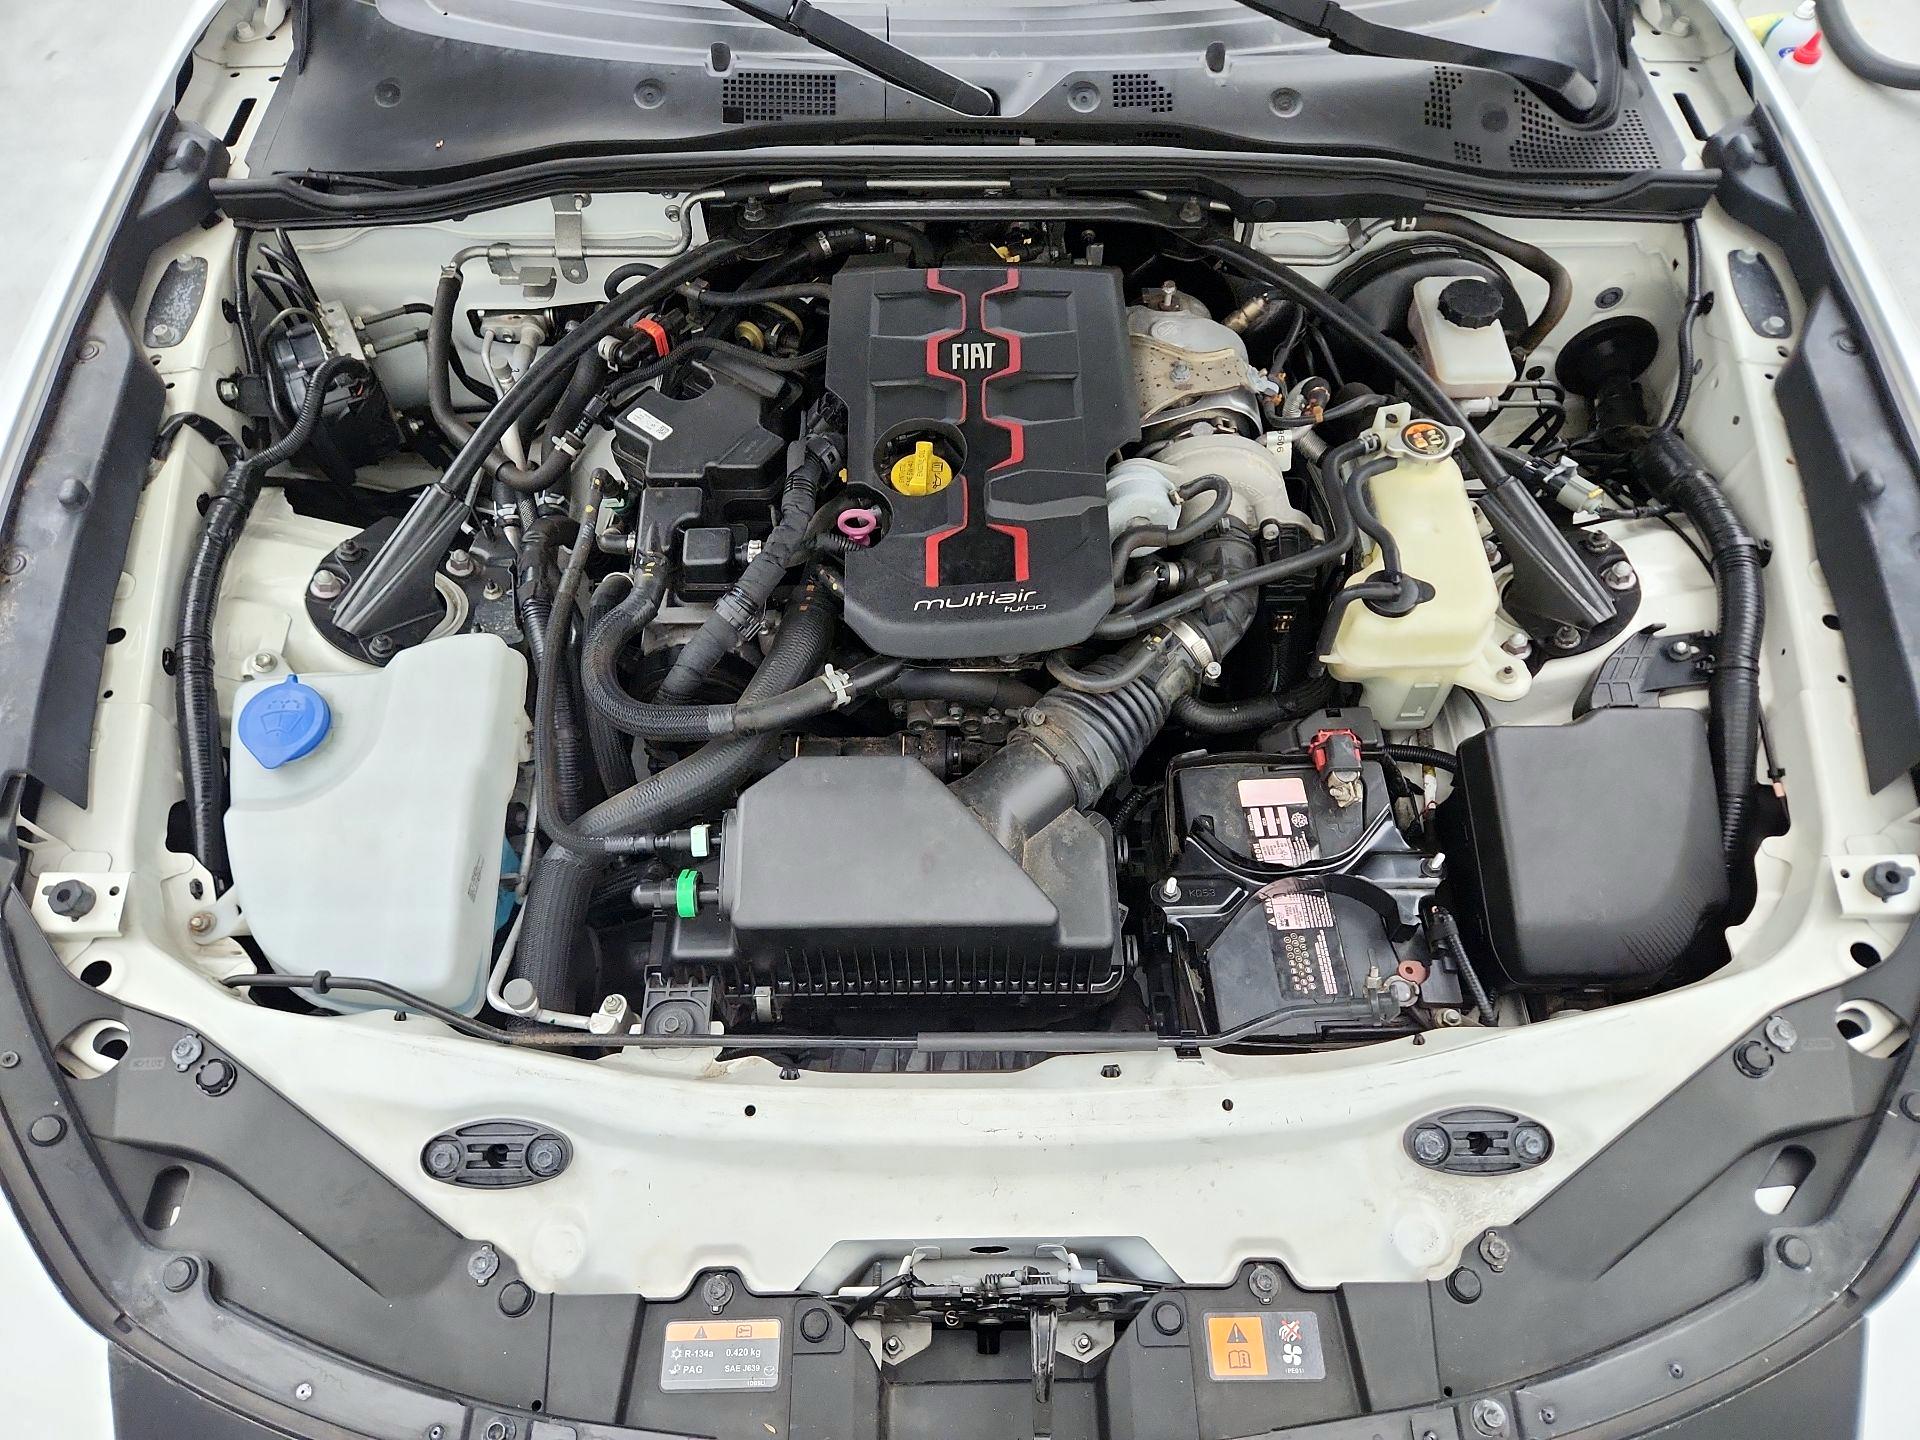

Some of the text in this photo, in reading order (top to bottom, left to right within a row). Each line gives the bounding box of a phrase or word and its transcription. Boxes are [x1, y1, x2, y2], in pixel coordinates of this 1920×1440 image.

[952, 342, 996, 370] FIAT
[913, 588, 1037, 611] multiair
[1003, 603, 1047, 612] turbo
[684, 1347, 761, 1359] R-134a 0.420 kg
[682, 1364, 761, 1374] PAG SAE J639
